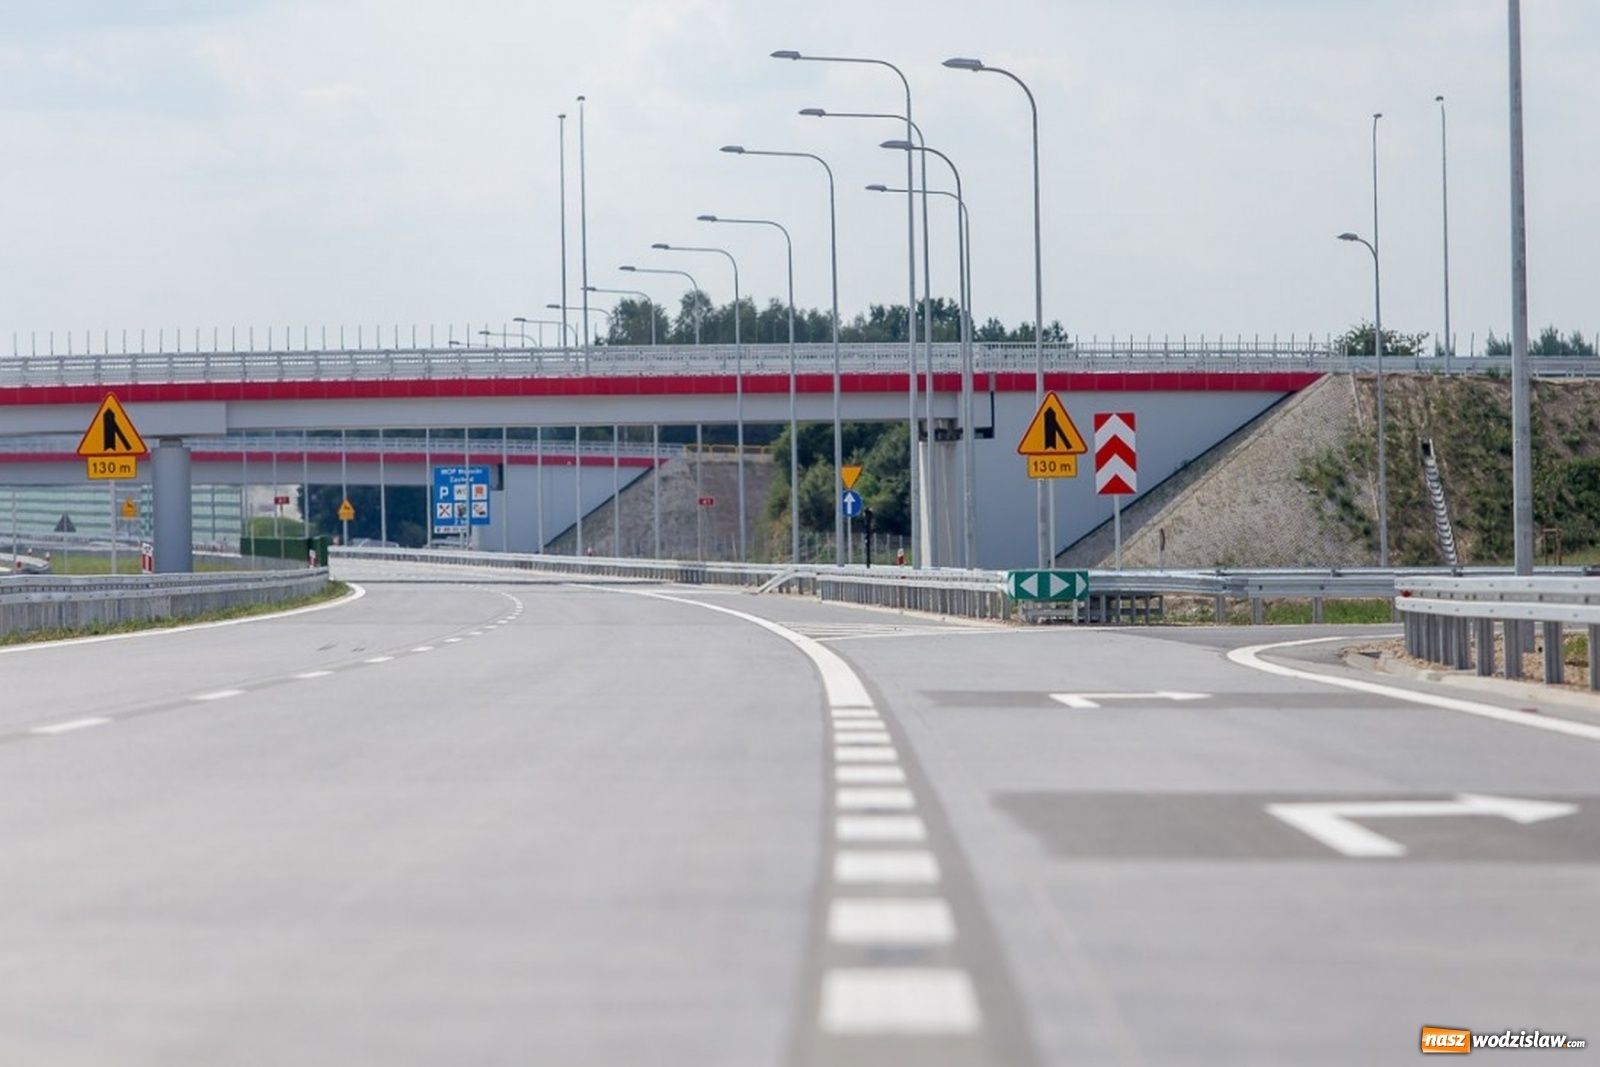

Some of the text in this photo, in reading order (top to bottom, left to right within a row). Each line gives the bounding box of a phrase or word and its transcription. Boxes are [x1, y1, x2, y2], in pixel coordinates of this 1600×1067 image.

[93, 461, 131, 474] 130 m
[1033, 460, 1071, 473] 130 m
[439, 486, 449, 500] P
